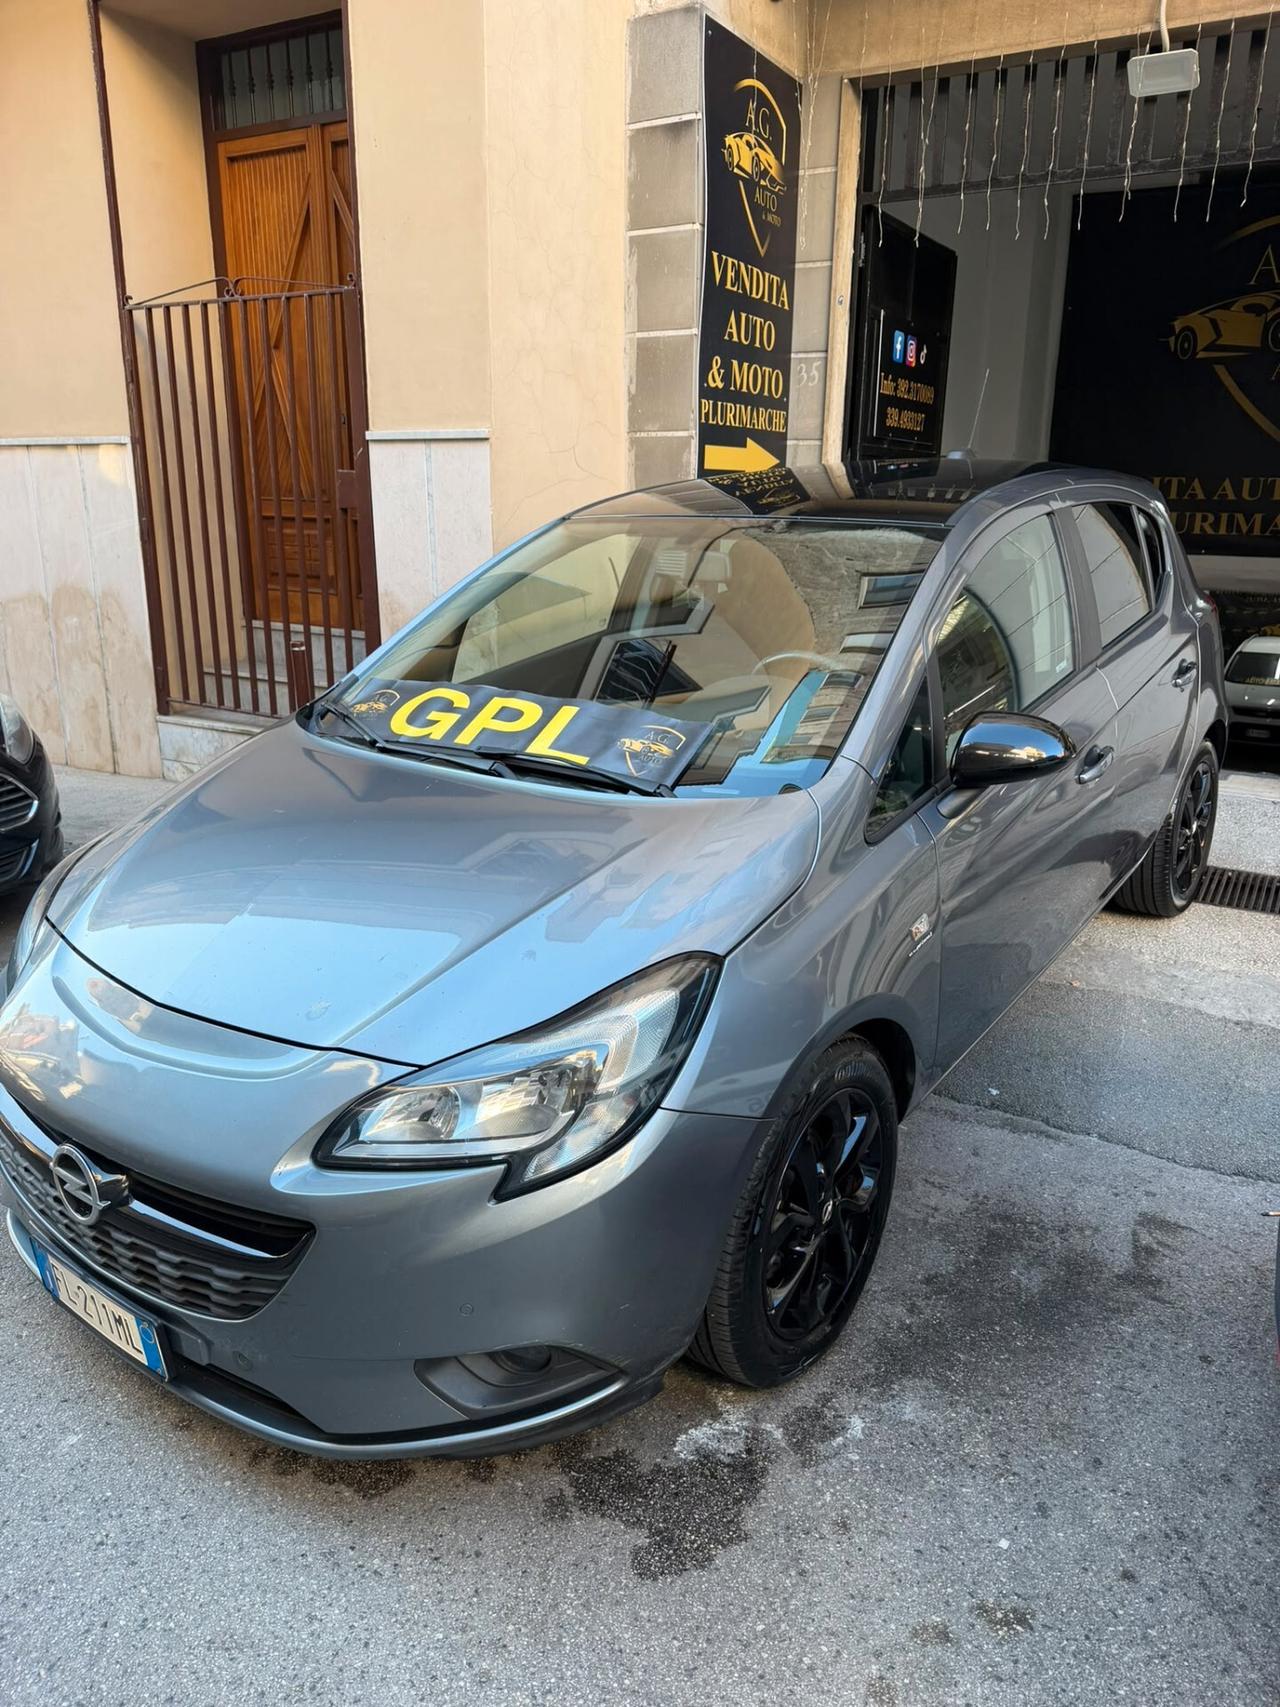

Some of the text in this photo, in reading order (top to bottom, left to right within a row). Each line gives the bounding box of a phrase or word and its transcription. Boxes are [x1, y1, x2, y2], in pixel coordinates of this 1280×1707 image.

[754, 185, 777, 212] AUTO
[711, 250, 790, 310] VENDITA
[724, 309, 776, 352] AUTO
[707, 355, 783, 399] & MOTO
[700, 399, 787, 433] PLURIMARCHE
[389, 687, 591, 767] GPL
